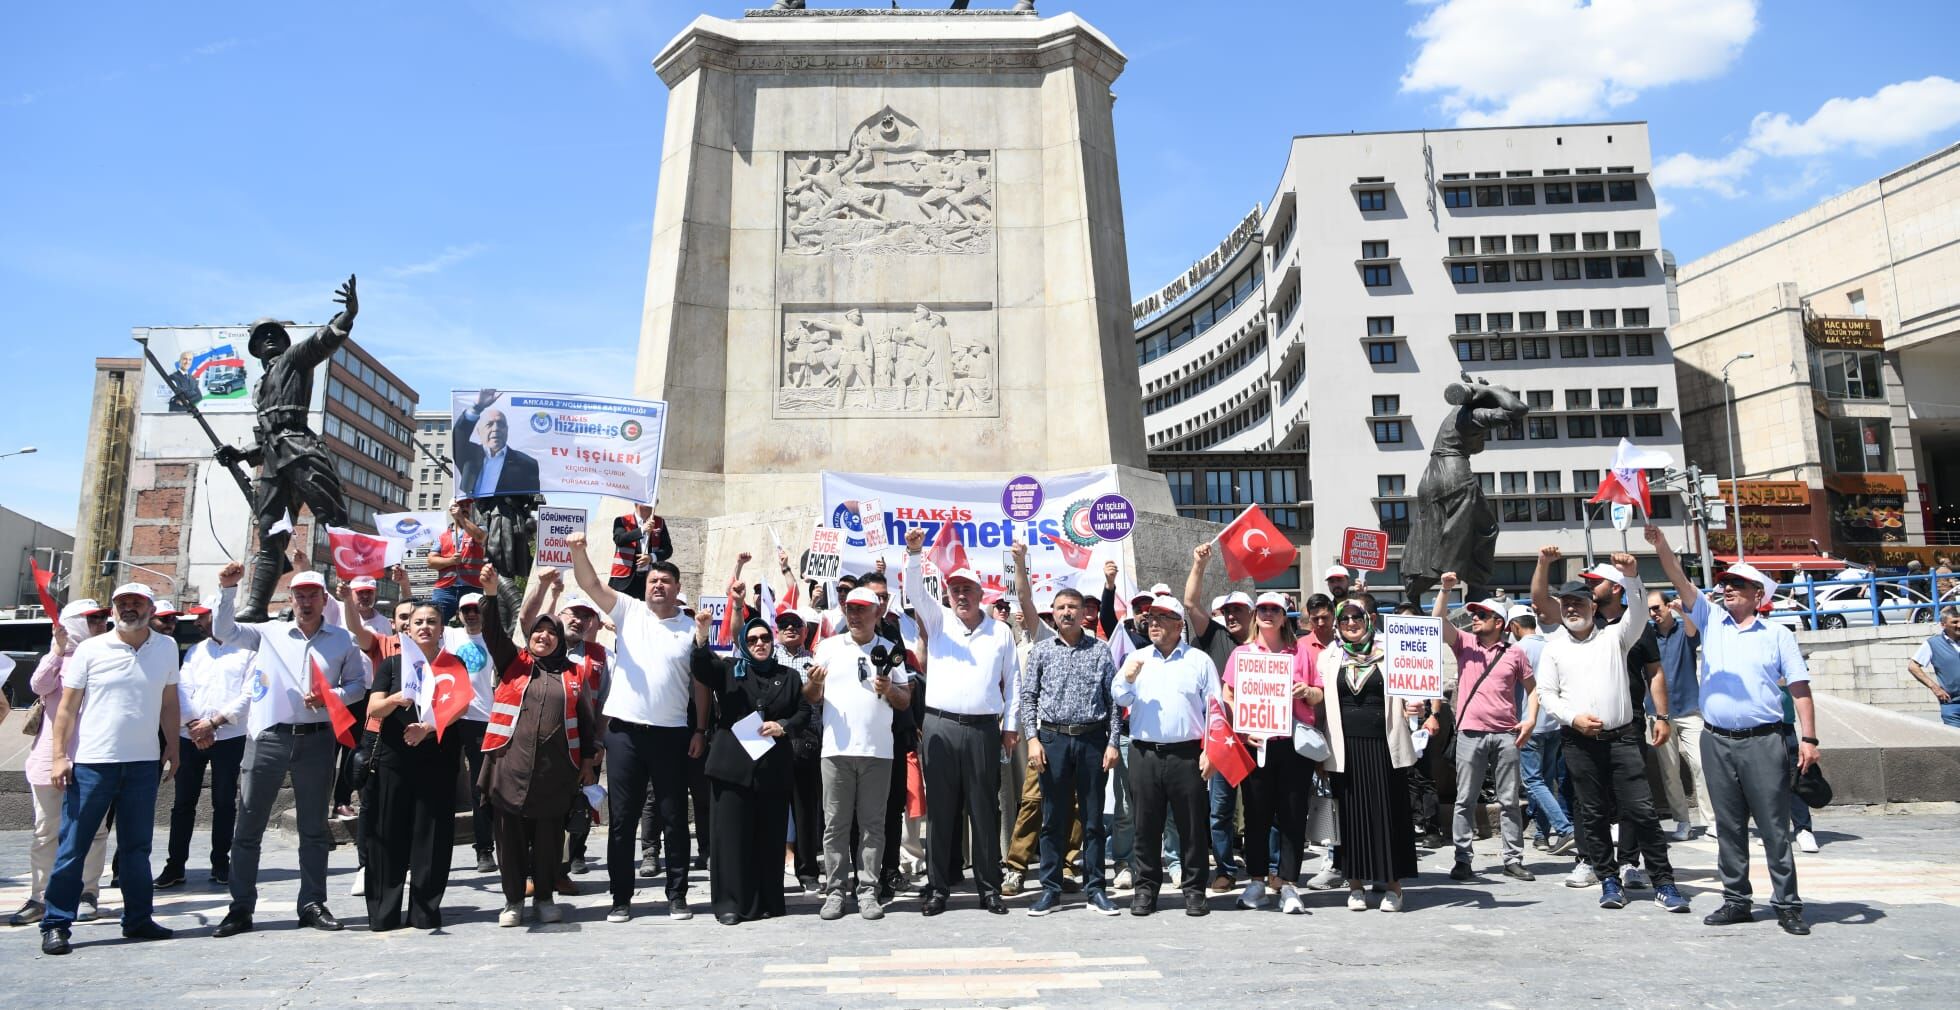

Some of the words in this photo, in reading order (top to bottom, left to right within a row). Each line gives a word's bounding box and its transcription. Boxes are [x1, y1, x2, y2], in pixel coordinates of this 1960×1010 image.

[1132, 294, 1160, 320] NKARA
[523, 399, 554, 407] ANKARA
[551, 447, 568, 457] EV
[576, 446, 641, 464] İŞÇİLERİ
[896, 506, 972, 521] HAK-İŞ
[1096, 503, 1104, 511] EV
[541, 511, 584, 523] GÖRÜNMEYEN
[544, 537, 569, 548] GÖRÜN
[814, 530, 839, 542] EMEK
[539, 550, 573, 563] HAKLA
[807, 554, 839, 578] EMEKTİR
[1389, 623, 1438, 636] GÖRÜNMEYEN
[1401, 639, 1427, 652] EMEĞE
[1239, 656, 1266, 673] EVDEKİ
[1268, 660, 1289, 674] EMEK
[1394, 655, 1434, 670] GÖRÜNÜR
[1242, 678, 1285, 697] GÖRÜNMEZ
[1388, 673, 1439, 691] HAKLAR!
[1239, 697, 1278, 729] DEĞİL
